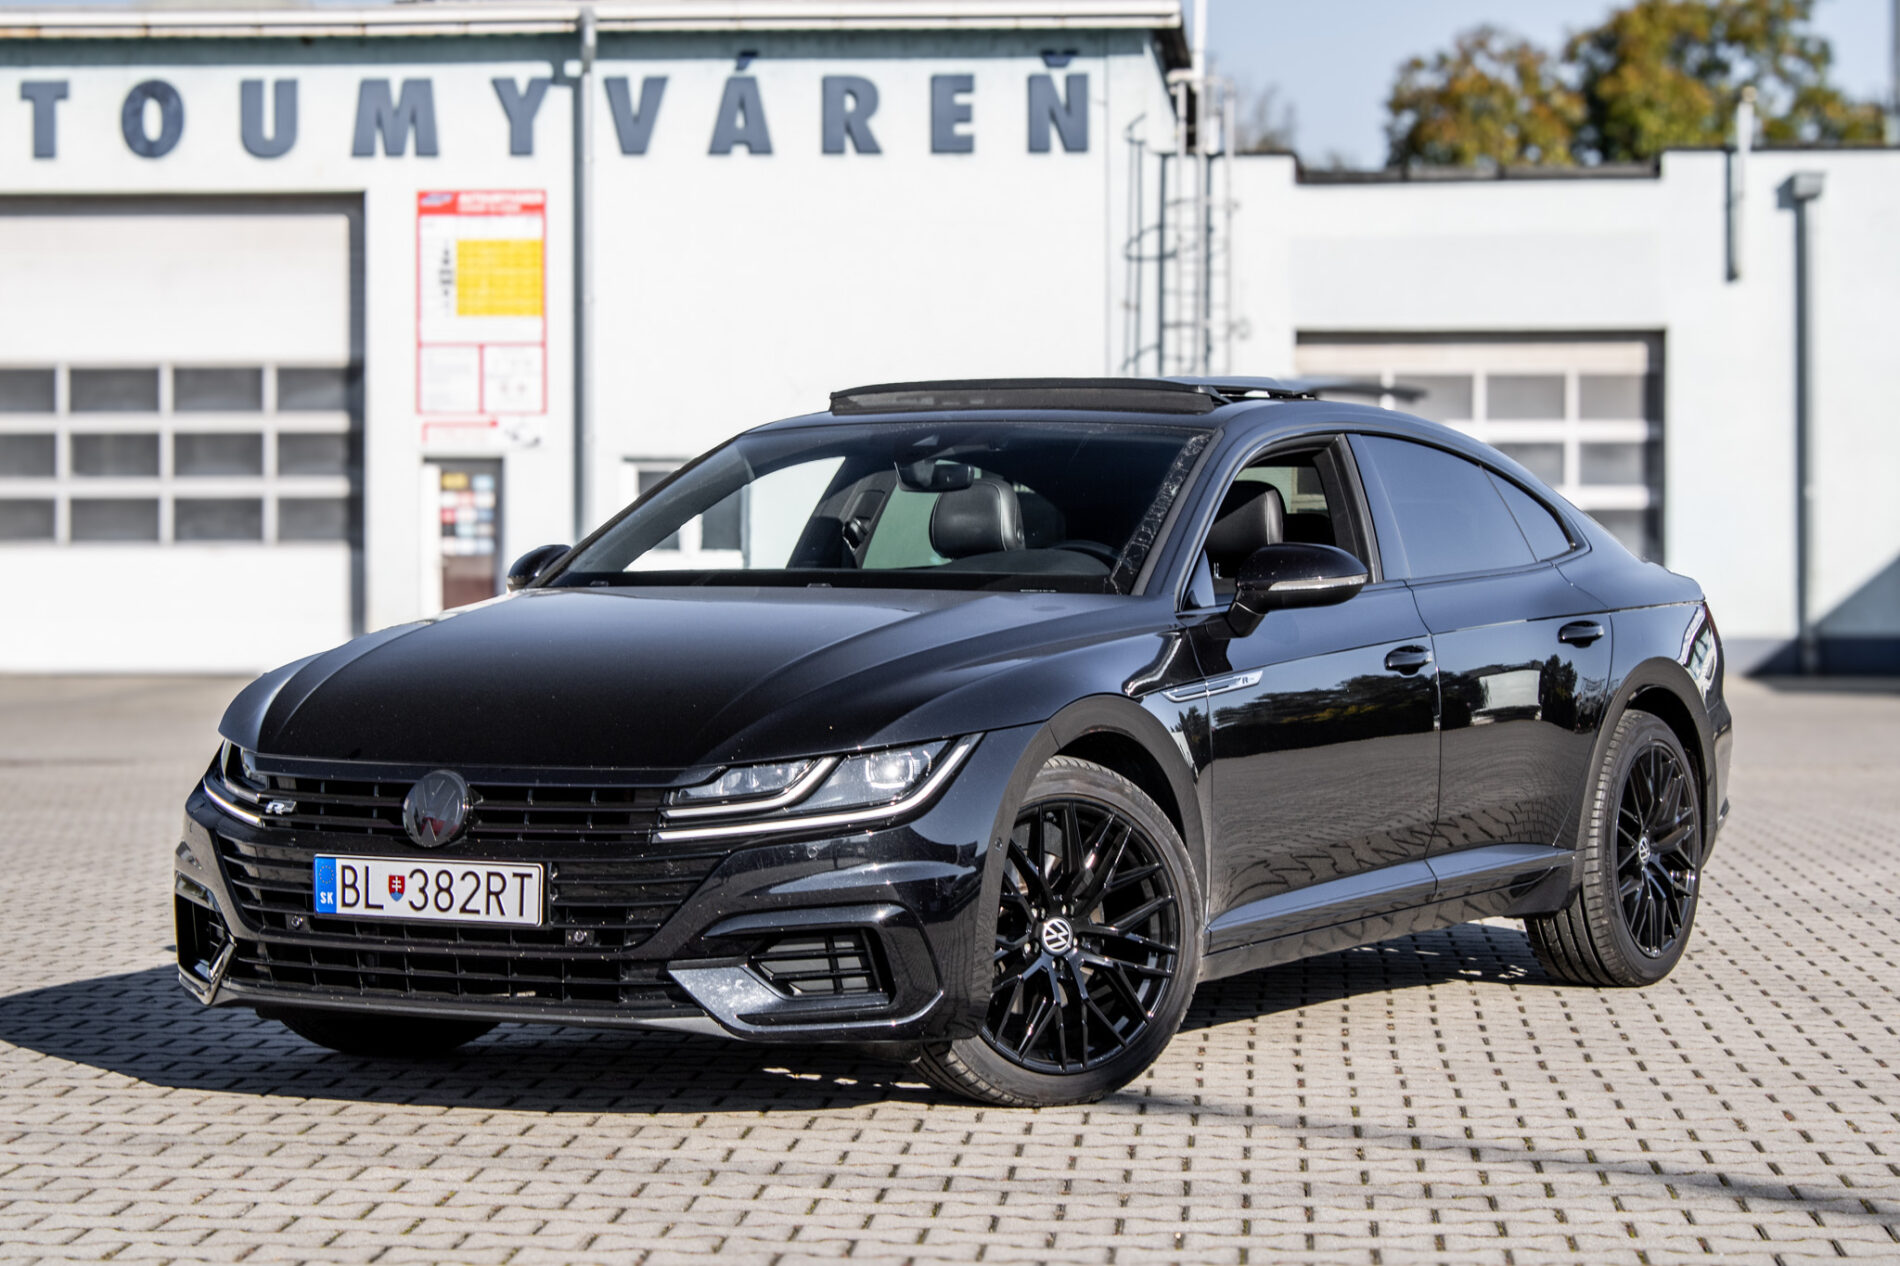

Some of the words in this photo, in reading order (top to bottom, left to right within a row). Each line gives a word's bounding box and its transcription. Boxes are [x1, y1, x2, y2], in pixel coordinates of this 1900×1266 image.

[319, 891, 334, 905] SK
[340, 864, 384, 910] BL
[408, 868, 533, 917] 382RT
